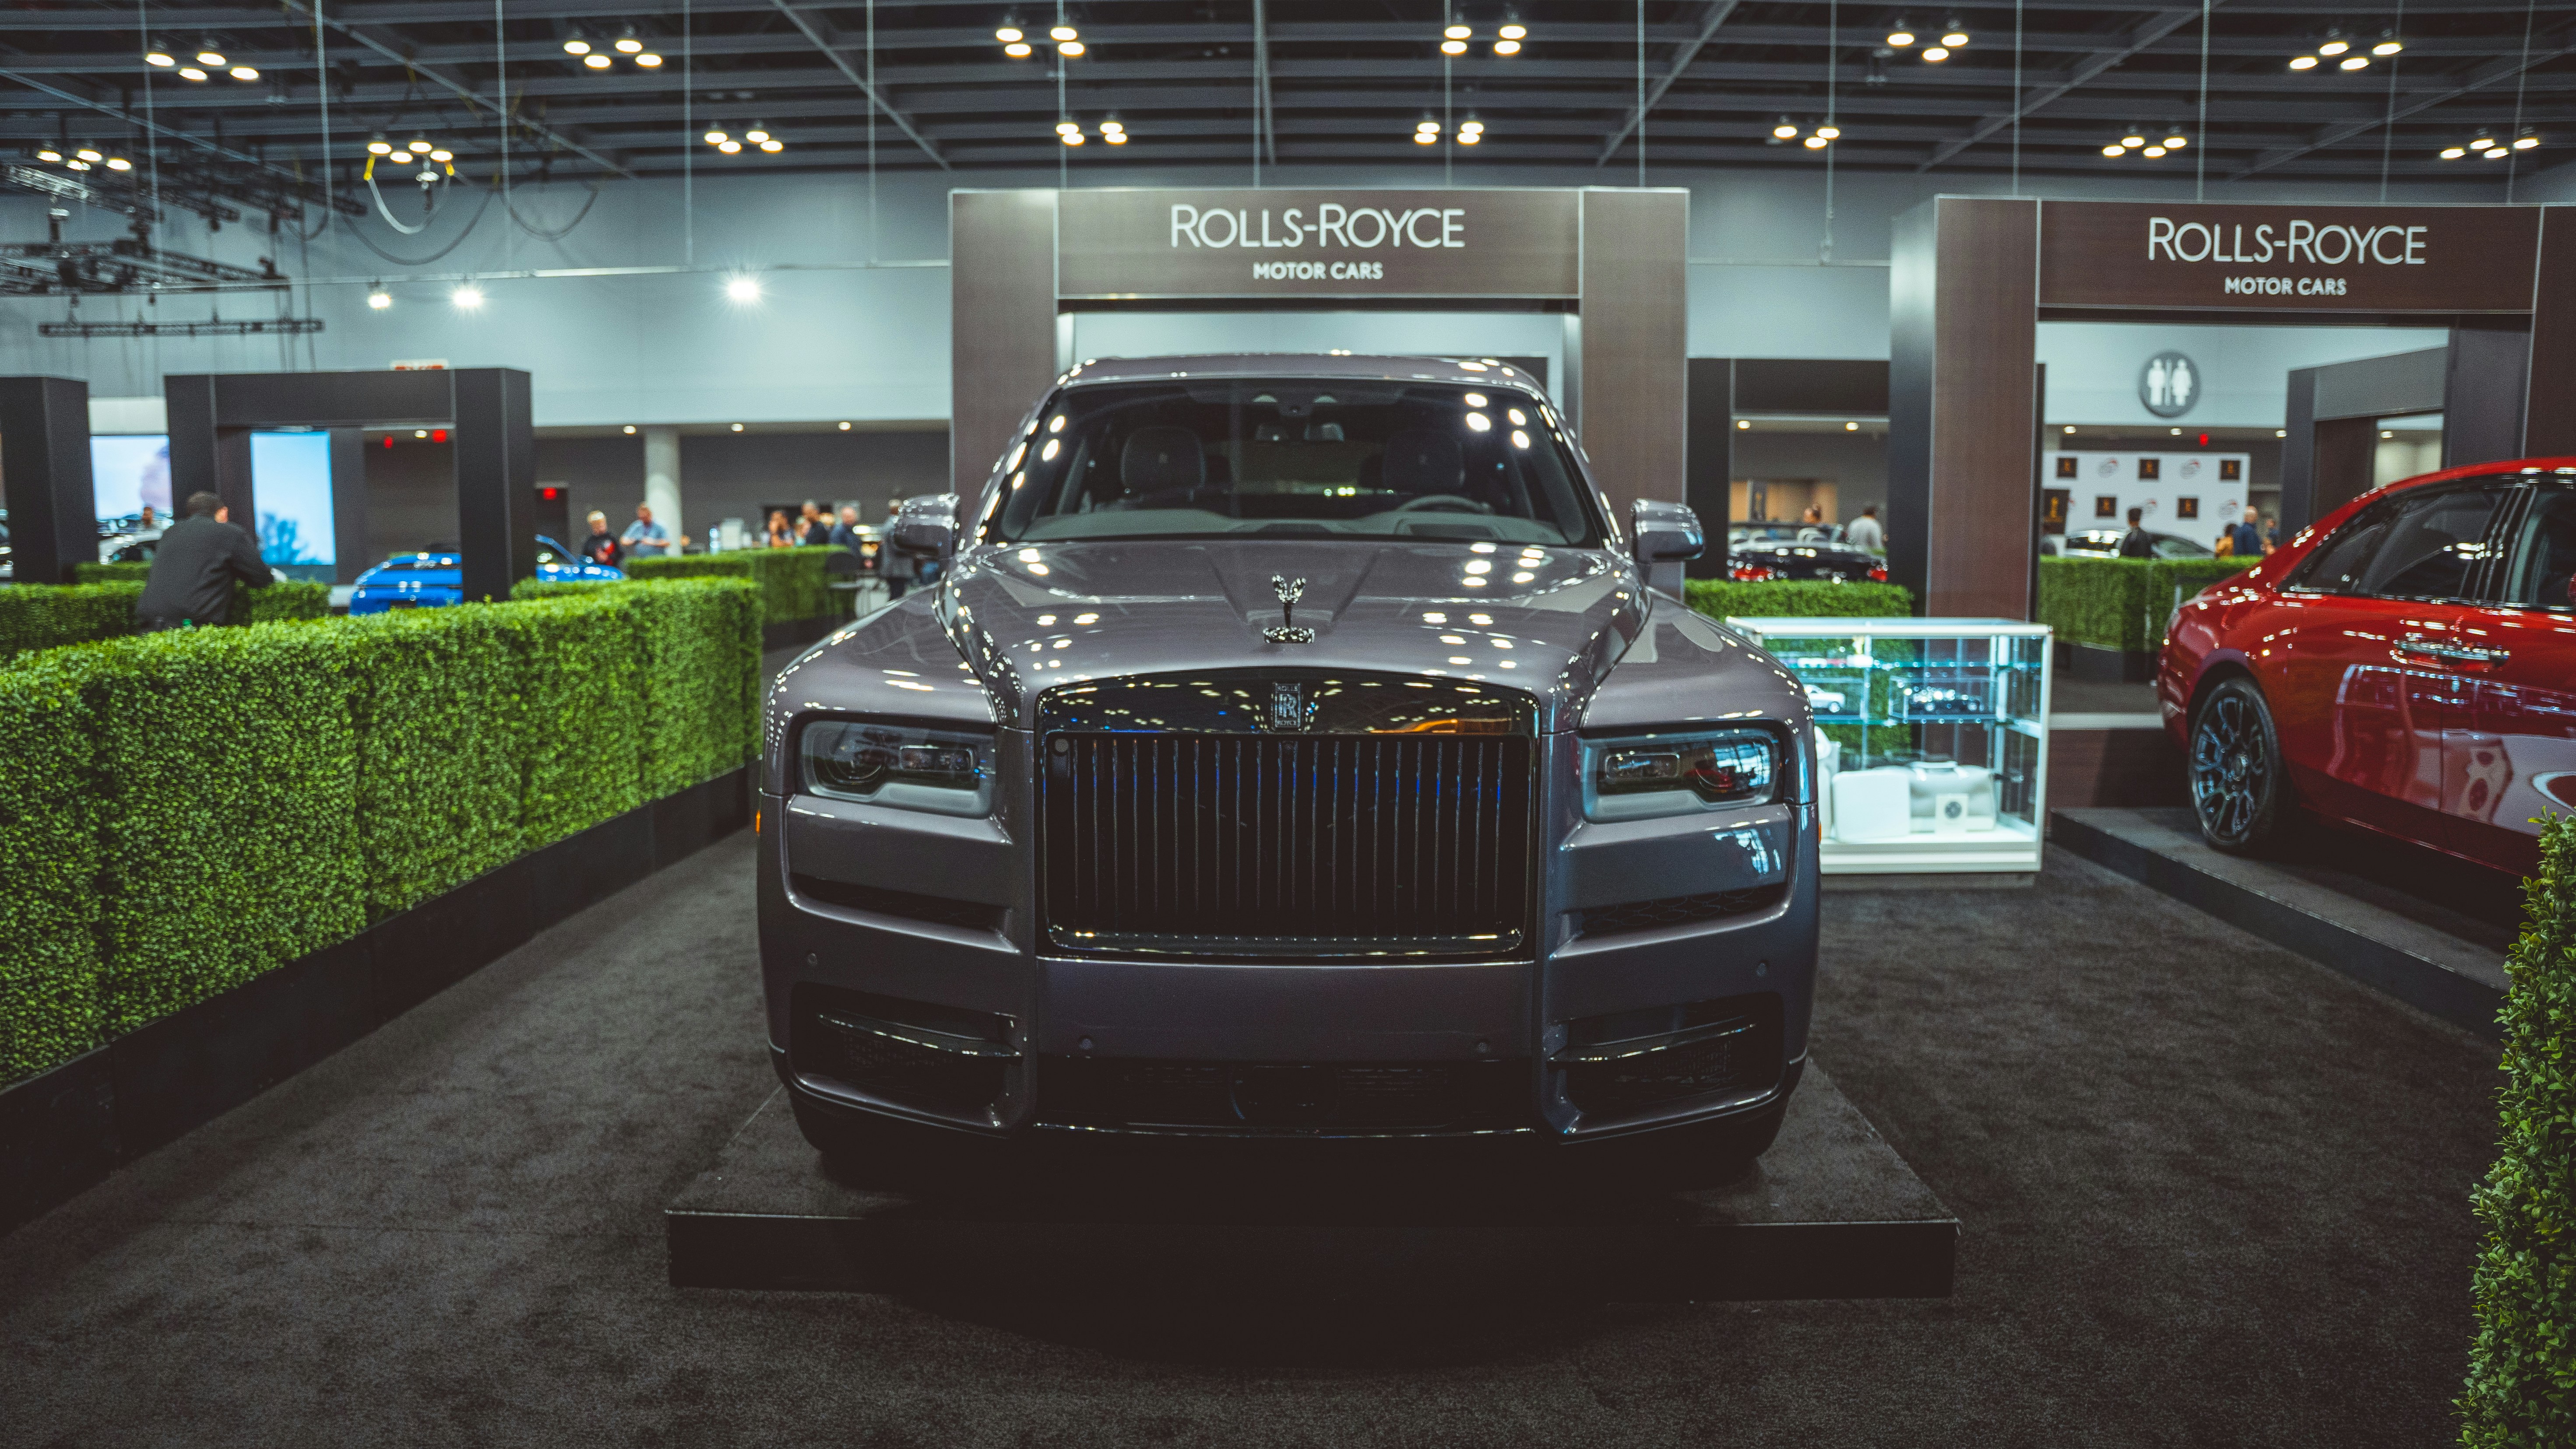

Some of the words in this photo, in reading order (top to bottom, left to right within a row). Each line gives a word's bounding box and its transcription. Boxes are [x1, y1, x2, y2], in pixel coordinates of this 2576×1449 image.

[1170, 203, 1464, 248] ROLLS-ROYCE
[2149, 218, 2426, 264] ROLLS-ROYCE
[1253, 262, 1325, 280] MOTOR
[1330, 262, 1383, 280] CARS
[2225, 278, 2292, 294] MOTOR
[2298, 278, 2346, 295] CARS
